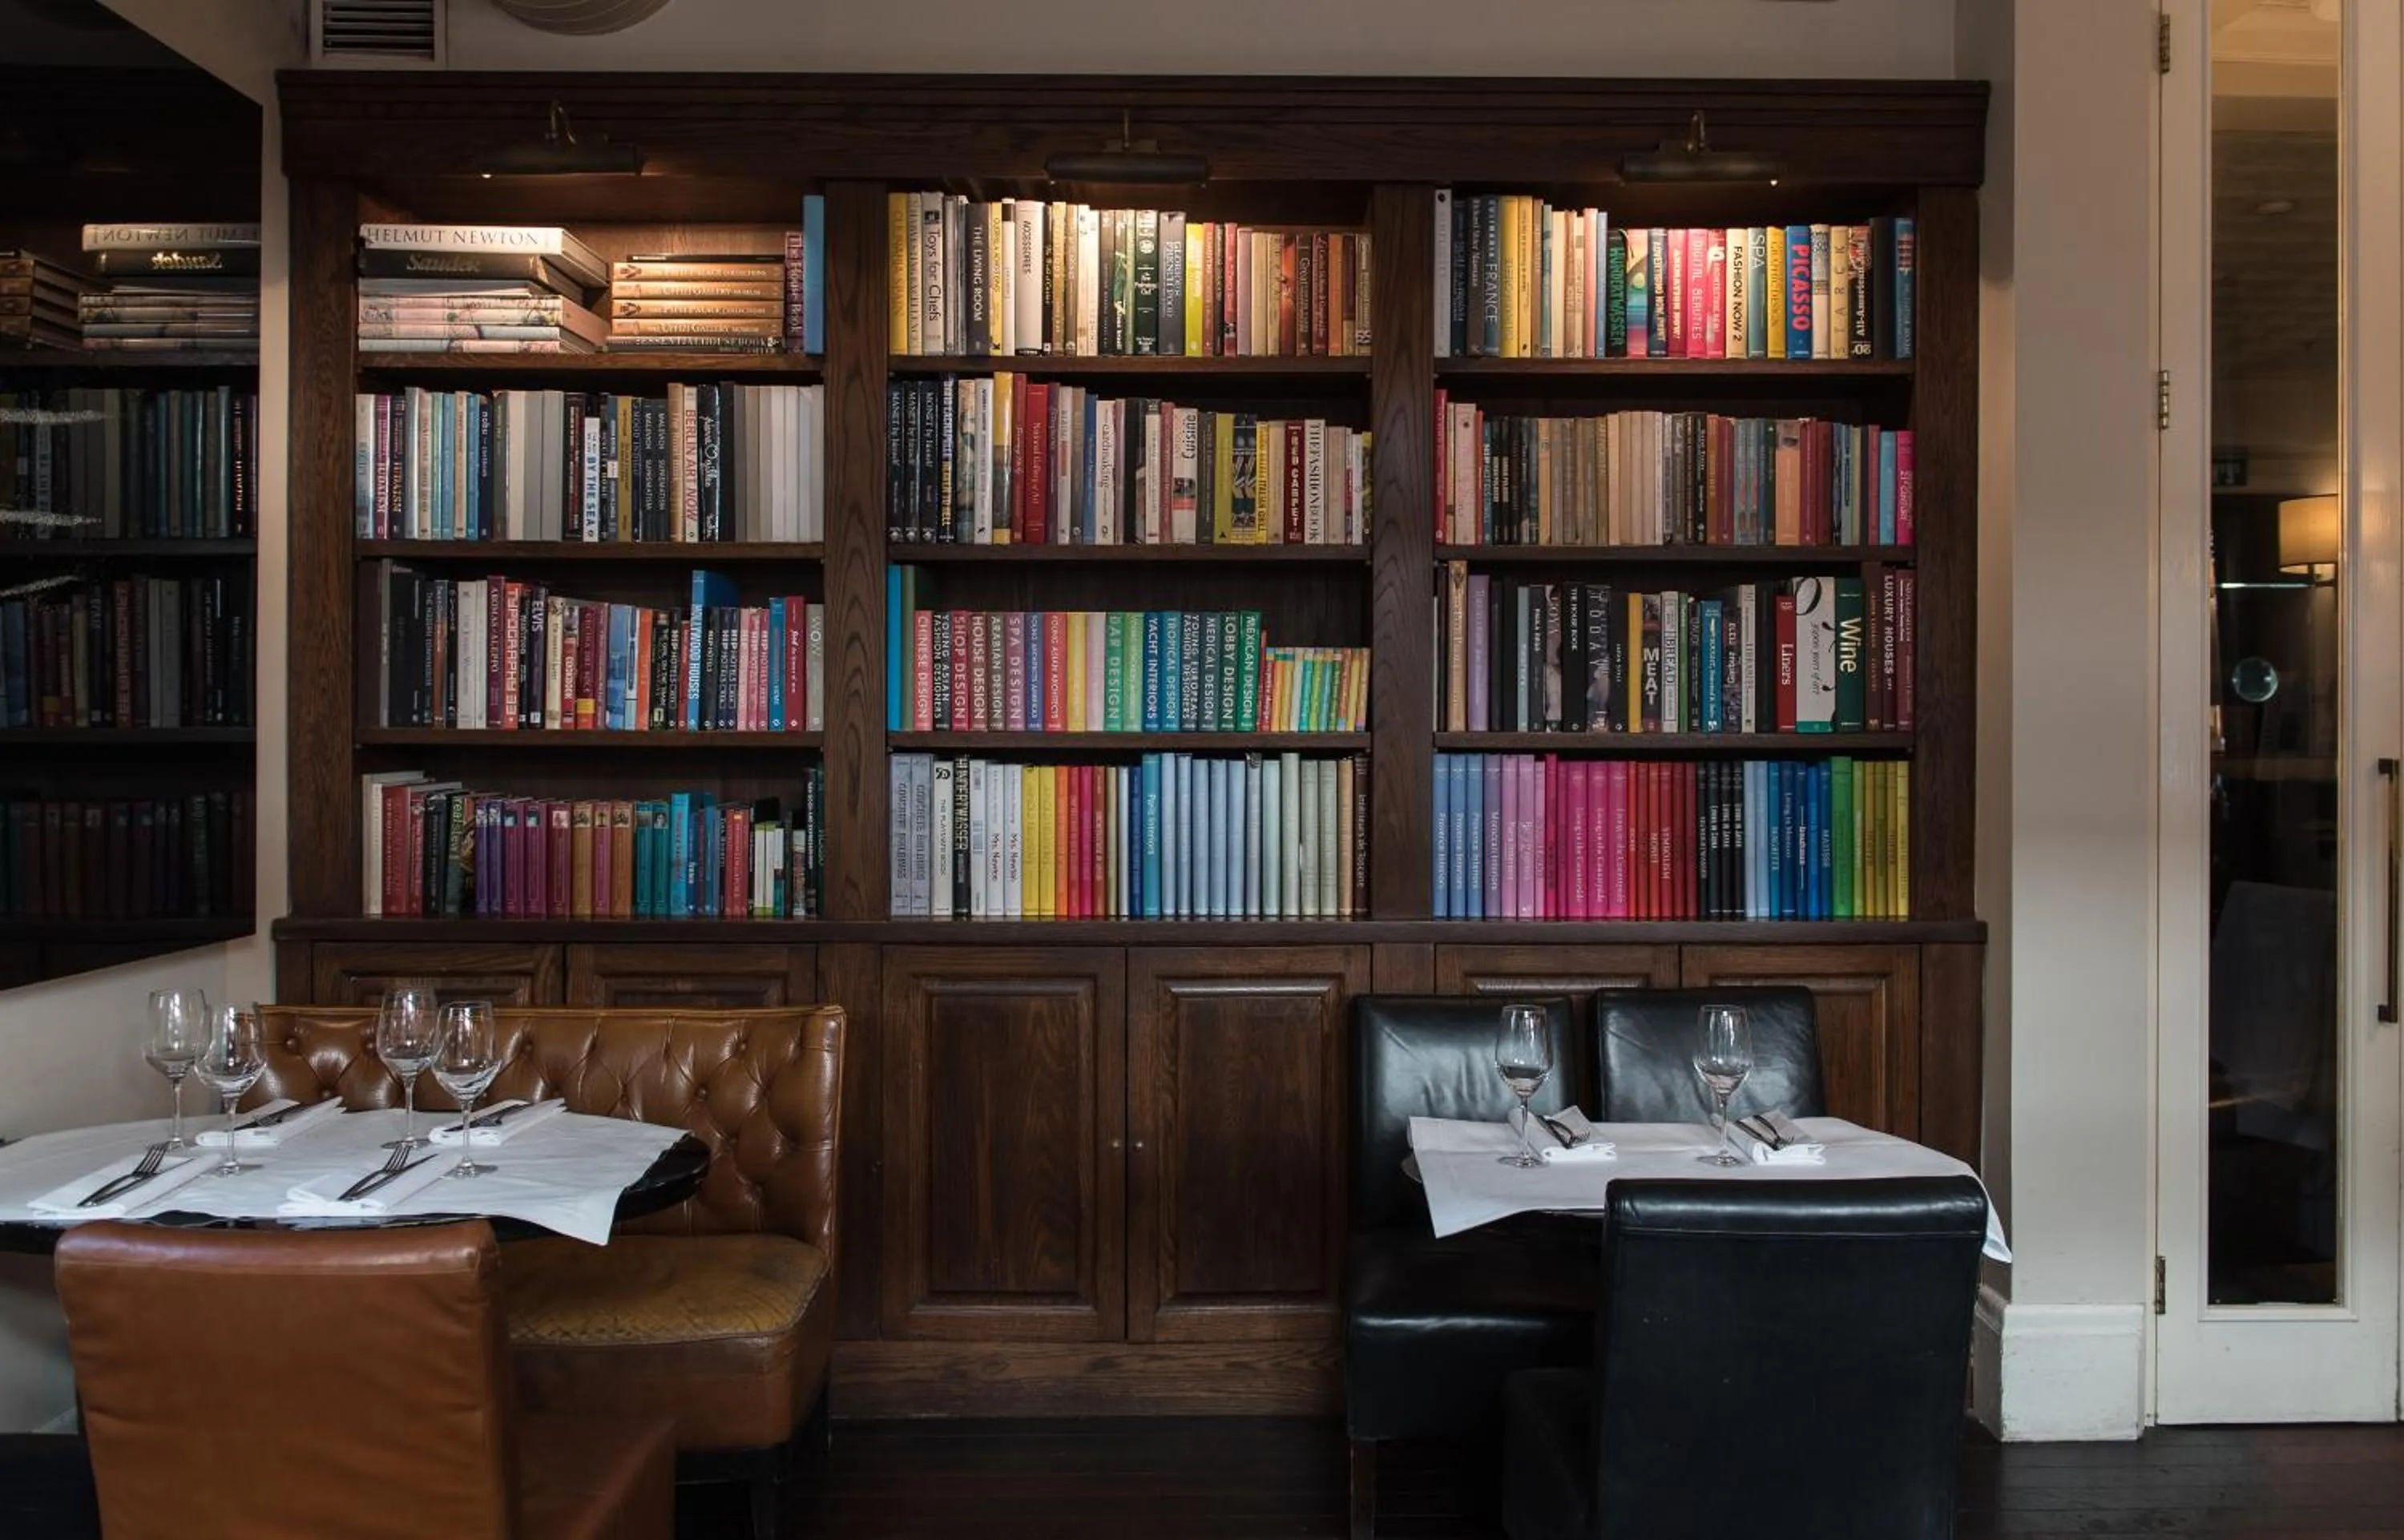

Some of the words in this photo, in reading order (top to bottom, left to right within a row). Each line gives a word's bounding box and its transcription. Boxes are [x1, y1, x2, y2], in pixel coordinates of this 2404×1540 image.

[366, 228, 449, 244] HELMUT
[453, 230, 539, 246] NEWTON
[925, 229, 941, 257] Toys
[973, 226, 983, 246] THE
[1750, 233, 1765, 270] SPA
[928, 262, 941, 280] for
[973, 249, 983, 284] LIVING
[1691, 240, 1703, 281] DIGITAL
[1732, 245, 1743, 298] FASHION
[928, 284, 941, 322] Chefs
[973, 288, 983, 322] ROOM
[1484, 263, 1498, 324] FRANCE
[1609, 246, 1626, 346] HUNDERTWASSER
[1792, 243, 1810, 331] PICASSO
[789, 304, 802, 333] Book
[1732, 301, 1743, 335] NOW
[481, 411, 491, 435] nobu
[891, 391, 902, 425] MANET
[907, 391, 918, 425] MANET
[924, 391, 935, 426] MONET
[685, 409, 697, 456] BERLIN
[1031, 422, 1042, 454] National
[1181, 415, 1196, 459] Cuisine
[587, 457, 597, 474] BY
[685, 458, 697, 486] ART
[1099, 423, 1115, 489] cardmaking
[376, 462, 387, 514] JUDAISM
[391, 462, 402, 514] JUDAISM
[587, 477, 597, 500] THE
[685, 488, 697, 521] NOW
[587, 503, 597, 526] SEA
[531, 601, 544, 631] ELVIS
[1884, 574, 1894, 623] LUXURY
[506, 588, 518, 691] TYPOGRAPHY
[670, 629, 679, 650] HIP
[689, 604, 703, 660] HOLLYWOOD
[720, 629, 728, 649] HIP
[730, 629, 738, 649] HIP
[918, 616, 928, 667] CHINESE
[933, 615, 942, 659] FASHION
[941, 615, 950, 658] YOUNG
[954, 616, 966, 656] SHOP
[972, 616, 984, 663] HOUSE
[991, 616, 1002, 669] ARABIAN
[1009, 617, 1020, 647] SPA
[1051, 615, 1059, 644] YOUNG
[1146, 618, 1158, 655] YACHT
[1166, 616, 1177, 671] TROPICAL
[1183, 615, 1192, 659] FASHION
[1191, 615, 1199, 655] YOUNG
[1204, 617, 1216, 669] MEDICAL
[1223, 616, 1236, 661] LOBBY
[1244, 616, 1256, 671] MEXICAN
[1589, 593, 1602, 667] TODAY
[1838, 617, 1861, 673] Wine
[1884, 625, 1894, 675] HOUSES
[689, 663, 703, 699] HOUSES
[730, 651, 738, 683] HOTELS
[941, 664, 950, 701] ASIAN
[1643, 647, 1660, 706] MEAT
[1665, 638, 1676, 684] BREAD
[1781, 643, 1794, 686] Liners
[918, 672, 928, 719] DESIGN
[933, 663, 942, 719] DESIGNERS
[954, 663, 966, 719] DESIGN
[972, 667, 984, 719] DESIGN
[991, 674, 1002, 719] DESIGN
[1009, 656, 1020, 719] DESIGN
[1051, 674, 1059, 719] ARCHITECTS
[1107, 656, 1120, 719] DESIGN
[1146, 659, 1158, 719] INTERIORS
[1166, 676, 1177, 719] DESIGN
[1183, 663, 1192, 720] DESIGNERS
[1191, 661, 1199, 720] EUROPEAN
[1204, 674, 1216, 720] DESIGN
[1223, 667, 1236, 720] DESIGN
[1244, 675, 1256, 719] DESIGN
[916, 784, 926, 832] CONCRETE
[954, 758, 969, 850] HUNDERTWASSER
[916, 834, 926, 881] BUILDINGS
